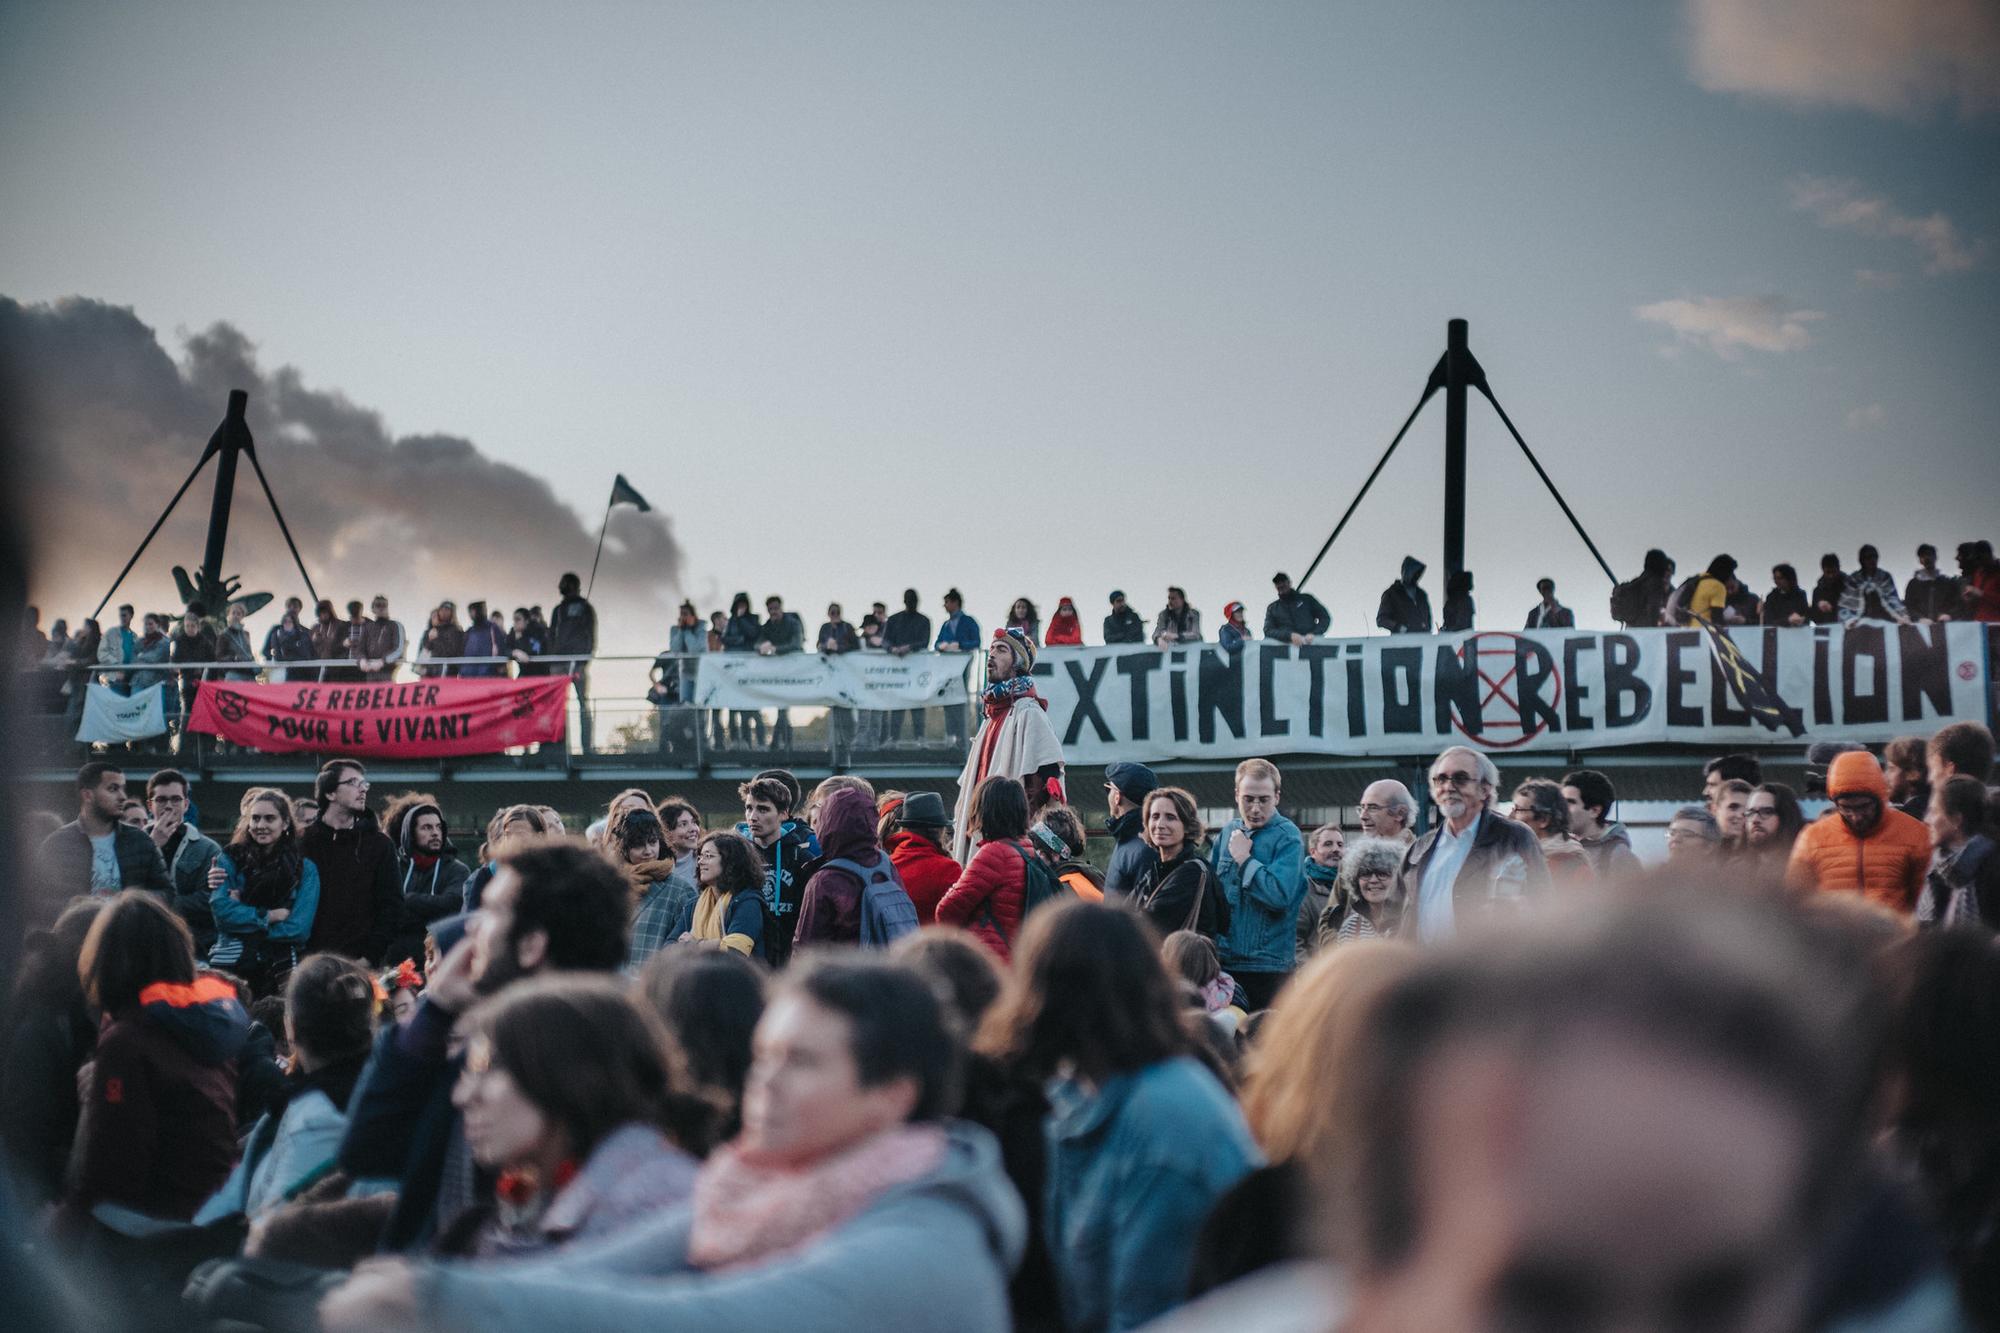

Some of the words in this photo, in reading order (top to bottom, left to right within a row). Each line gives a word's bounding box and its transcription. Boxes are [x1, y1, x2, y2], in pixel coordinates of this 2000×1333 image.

[292, 688, 318, 710] SE
[327, 685, 440, 710] REBELLER
[267, 714, 328, 743] POUR
[341, 717, 364, 744] LE
[376, 713, 472, 743] VIVANT
